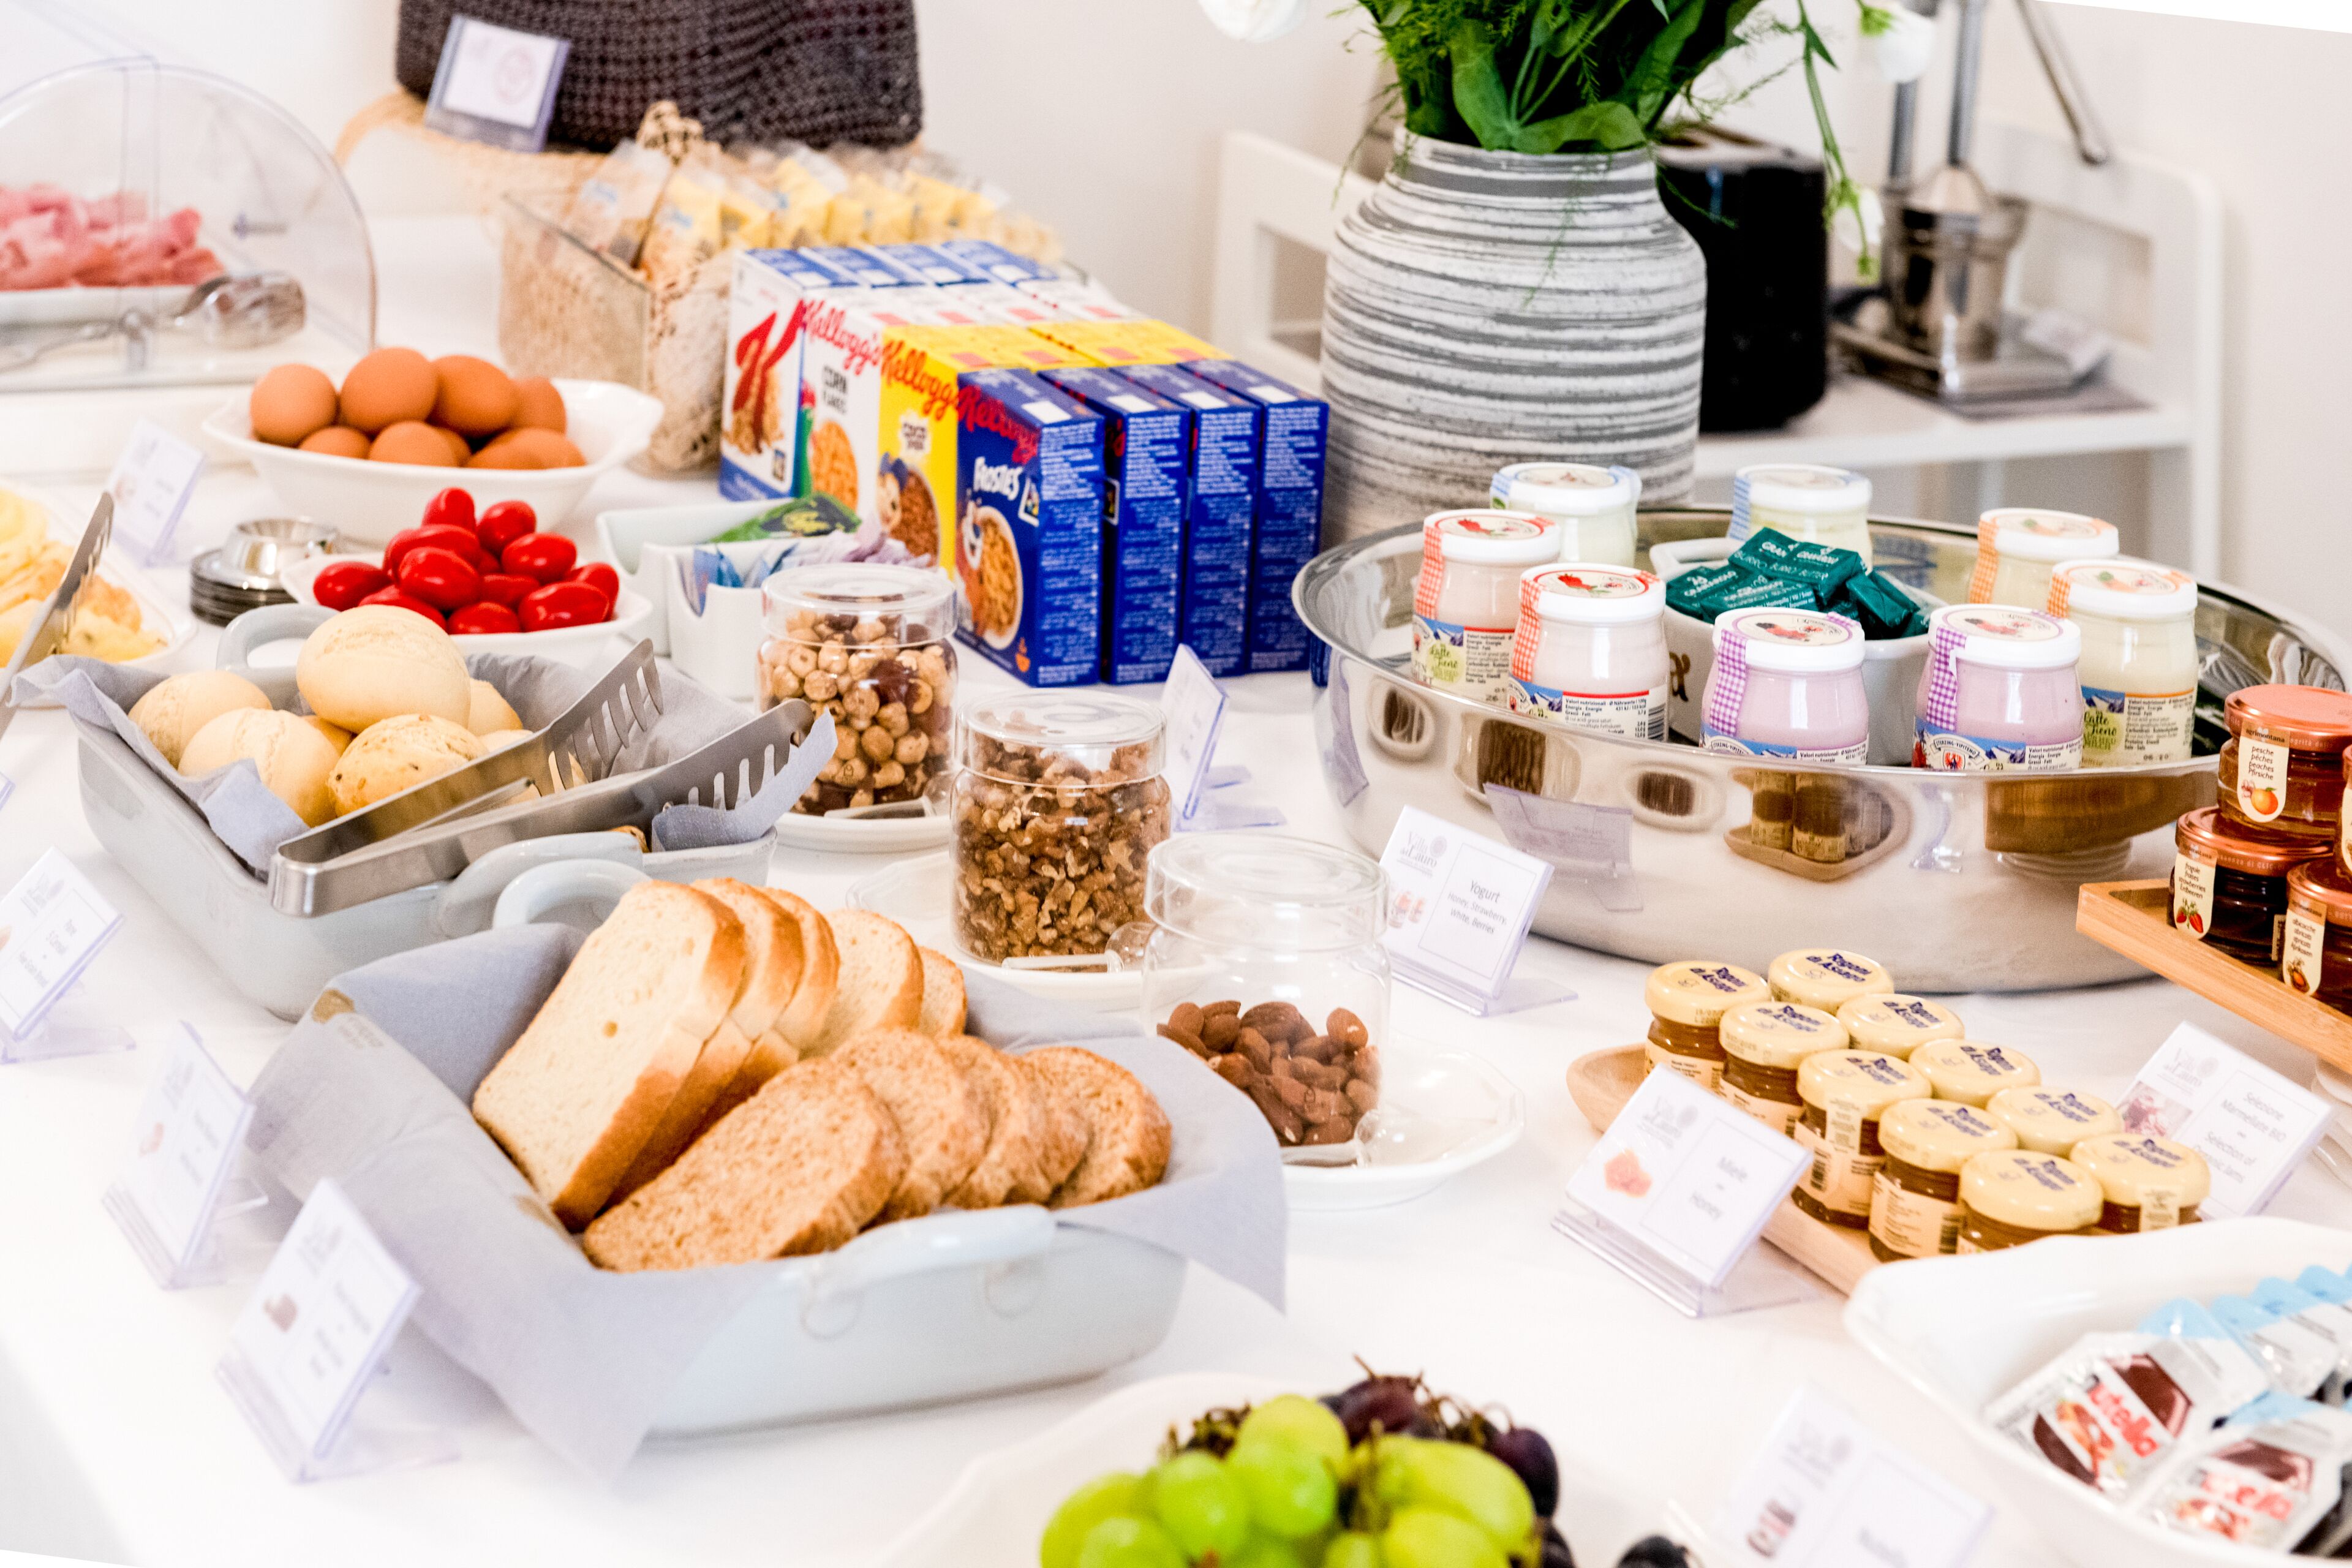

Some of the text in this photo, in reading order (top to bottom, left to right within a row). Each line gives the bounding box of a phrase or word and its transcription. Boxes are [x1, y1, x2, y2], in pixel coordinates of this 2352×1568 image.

[798, 300, 882, 376] Kellogg's
[2245, 727, 2286, 743] agrimontana
[2251, 754, 2274, 764] pêches
[2252, 746, 2274, 756] pesche
[2248, 768, 2274, 780] Pfirsiche
[2249, 761, 2274, 772] peaches
[1408, 845, 1438, 869] Lauro
[1470, 879, 1501, 903] Yogurt
[1447, 891, 1507, 925] Honey, Strawberry,
[1450, 907, 1495, 934] White, Berries
[2205, 1131, 2244, 1161] Selection
